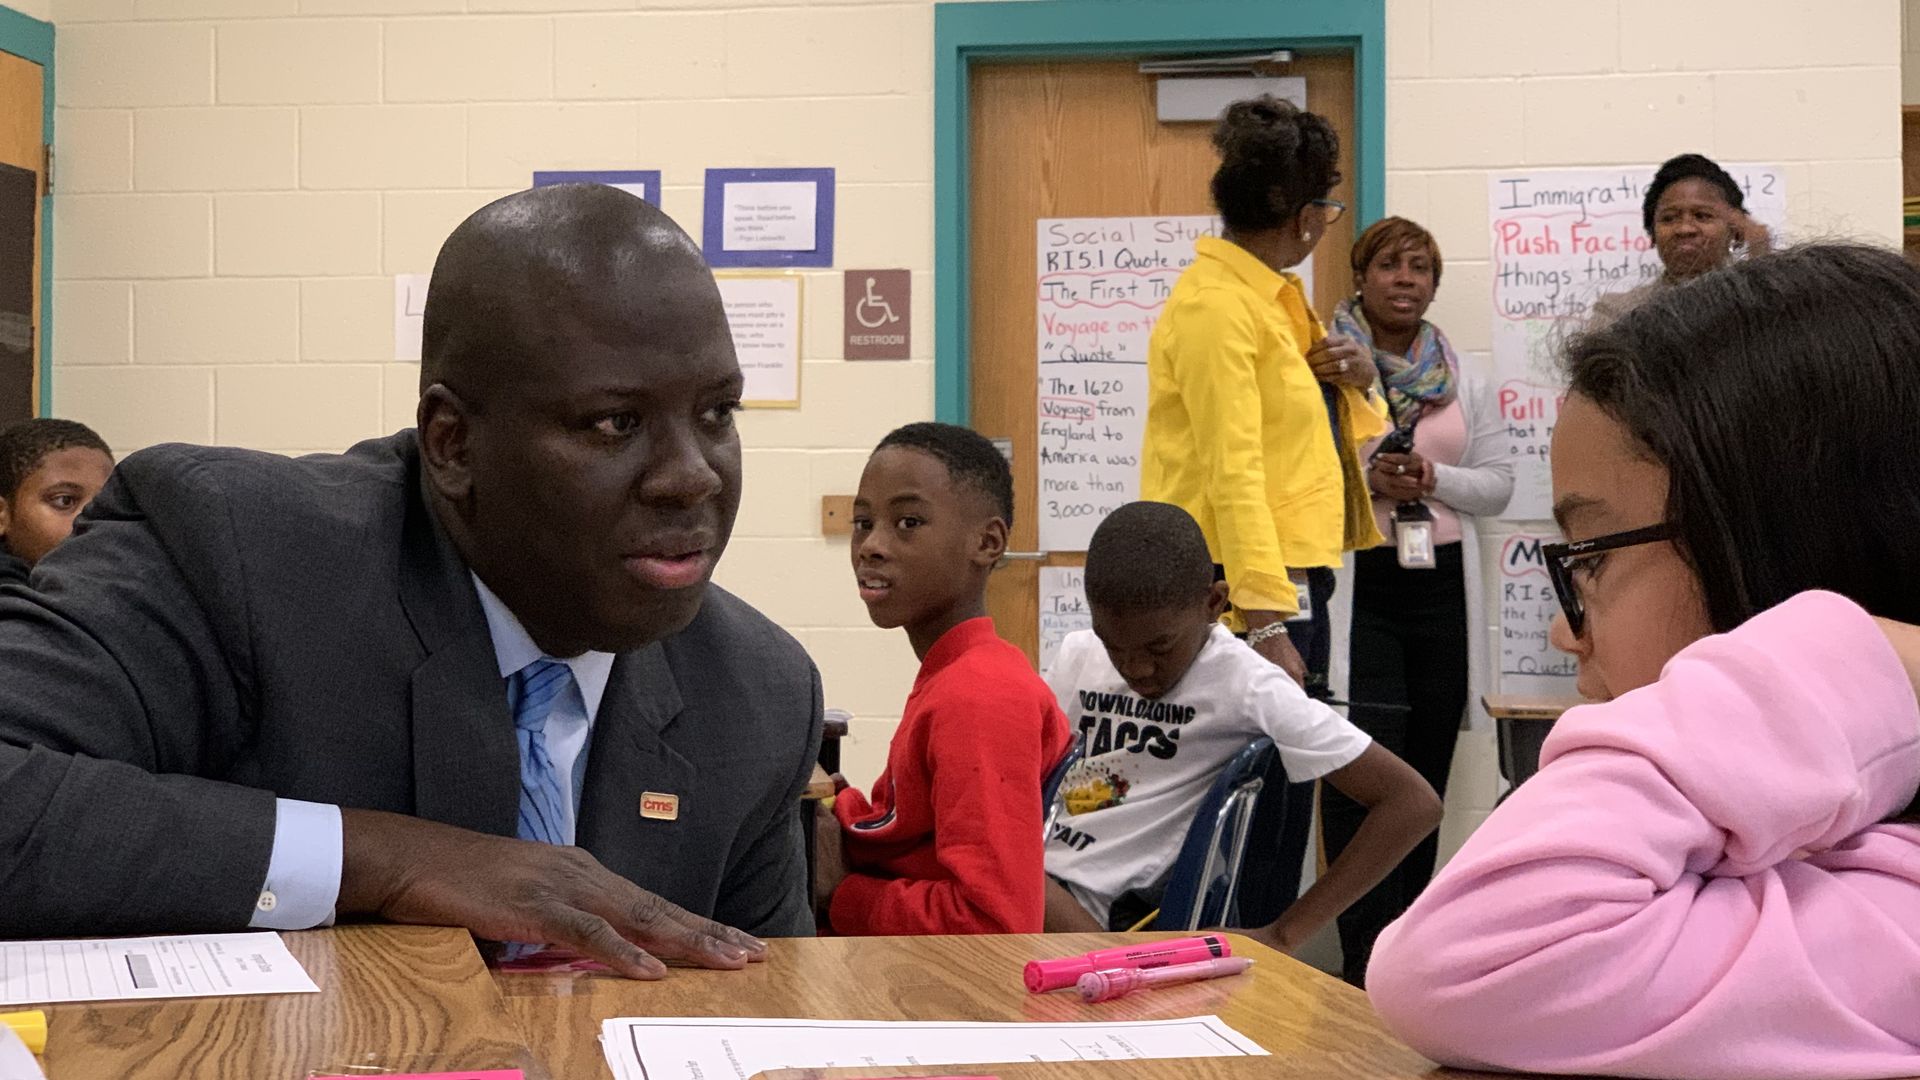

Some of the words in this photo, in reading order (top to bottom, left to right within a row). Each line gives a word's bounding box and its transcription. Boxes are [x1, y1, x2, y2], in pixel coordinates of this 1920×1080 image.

[1762, 174, 1775, 195] 2
[1049, 222, 1135, 247] Social
[1501, 222, 1560, 255] Push
[1571, 224, 1652, 255] Facto
[1114, 248, 1168, 270] Quote
[1498, 262, 1571, 299] things
[1584, 256, 1629, 280] that
[1043, 281, 1079, 301] The
[1090, 279, 1138, 299] First
[1149, 278, 1172, 298] Th
[405, 286, 424, 317] L
[1505, 296, 1557, 316] want
[1565, 293, 1587, 315] to
[850, 335, 905, 345] RESTROOM
[1043, 313, 1109, 347] Voyage
[1118, 321, 1138, 333] on
[1084, 379, 1124, 396] 1620
[1043, 401, 1092, 425] Voyage
[1096, 401, 1135, 417] from
[1498, 389, 1544, 420] Pull
[1041, 422, 1097, 450] England
[1103, 425, 1123, 441] to
[1508, 424, 1534, 437] hat
[1040, 446, 1100, 465] America
[1106, 455, 1137, 466] was
[1044, 478, 1079, 492] more
[1087, 472, 1125, 492] than
[1510, 539, 1543, 566] M
[1060, 572, 1082, 589] Un
[1503, 606, 1526, 620] the
[1504, 627, 1548, 652] using
[644, 800, 673, 811] cms
